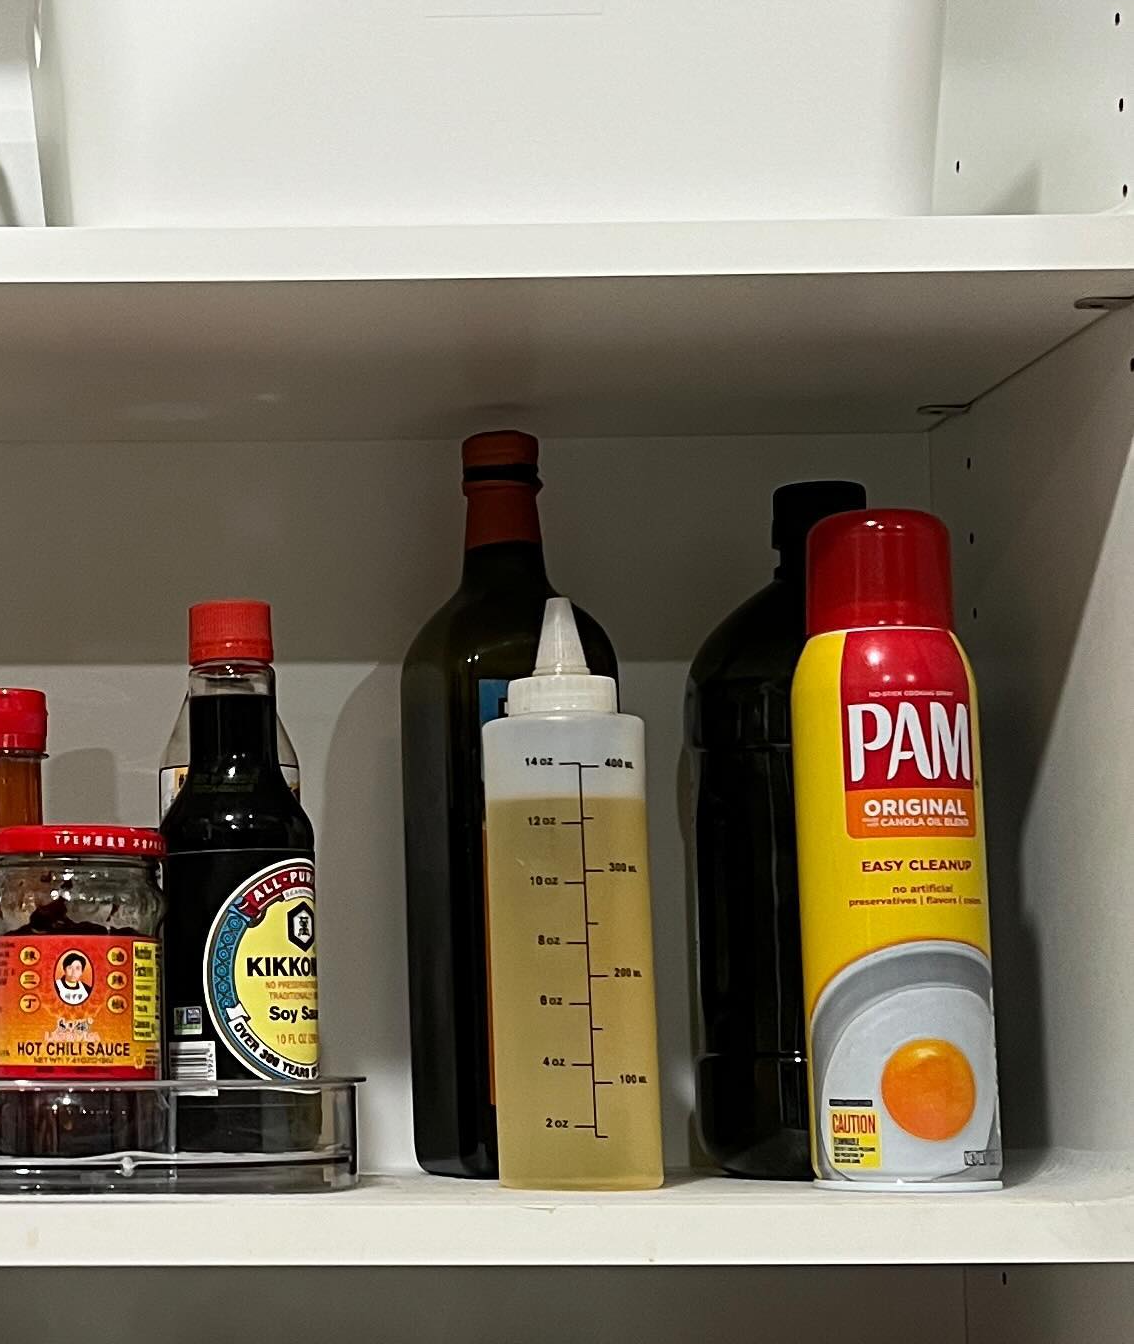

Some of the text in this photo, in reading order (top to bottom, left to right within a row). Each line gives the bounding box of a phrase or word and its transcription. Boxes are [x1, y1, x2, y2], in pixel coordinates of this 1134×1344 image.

[847, 701, 971, 782] PAM
[525, 758, 538, 766] 14
[604, 759, 623, 768] 400
[864, 799, 966, 817] ORIGINAL
[528, 816, 541, 826] 12
[880, 817, 926, 827] CANOLA
[926, 817, 943, 826] OIL
[608, 863, 627, 873] 300
[861, 859, 972, 873] EASY CLEANUP
[530, 876, 543, 886] 10
[892, 883, 953, 893] no artificial
[849, 897, 917, 908] preservatives
[538, 935, 545, 945] 8
[614, 968, 631, 978] 200
[540, 995, 547, 1006] 6
[269, 1006, 298, 1024] Soy
[234, 1021, 260, 1053] OVER
[17, 1042, 130, 1056] HOT CHILI SAUCE
[543, 1057, 550, 1067] 4
[620, 1075, 637, 1084] 100
[545, 1118, 553, 1128] 2
[832, 1113, 876, 1134] CAUTION
